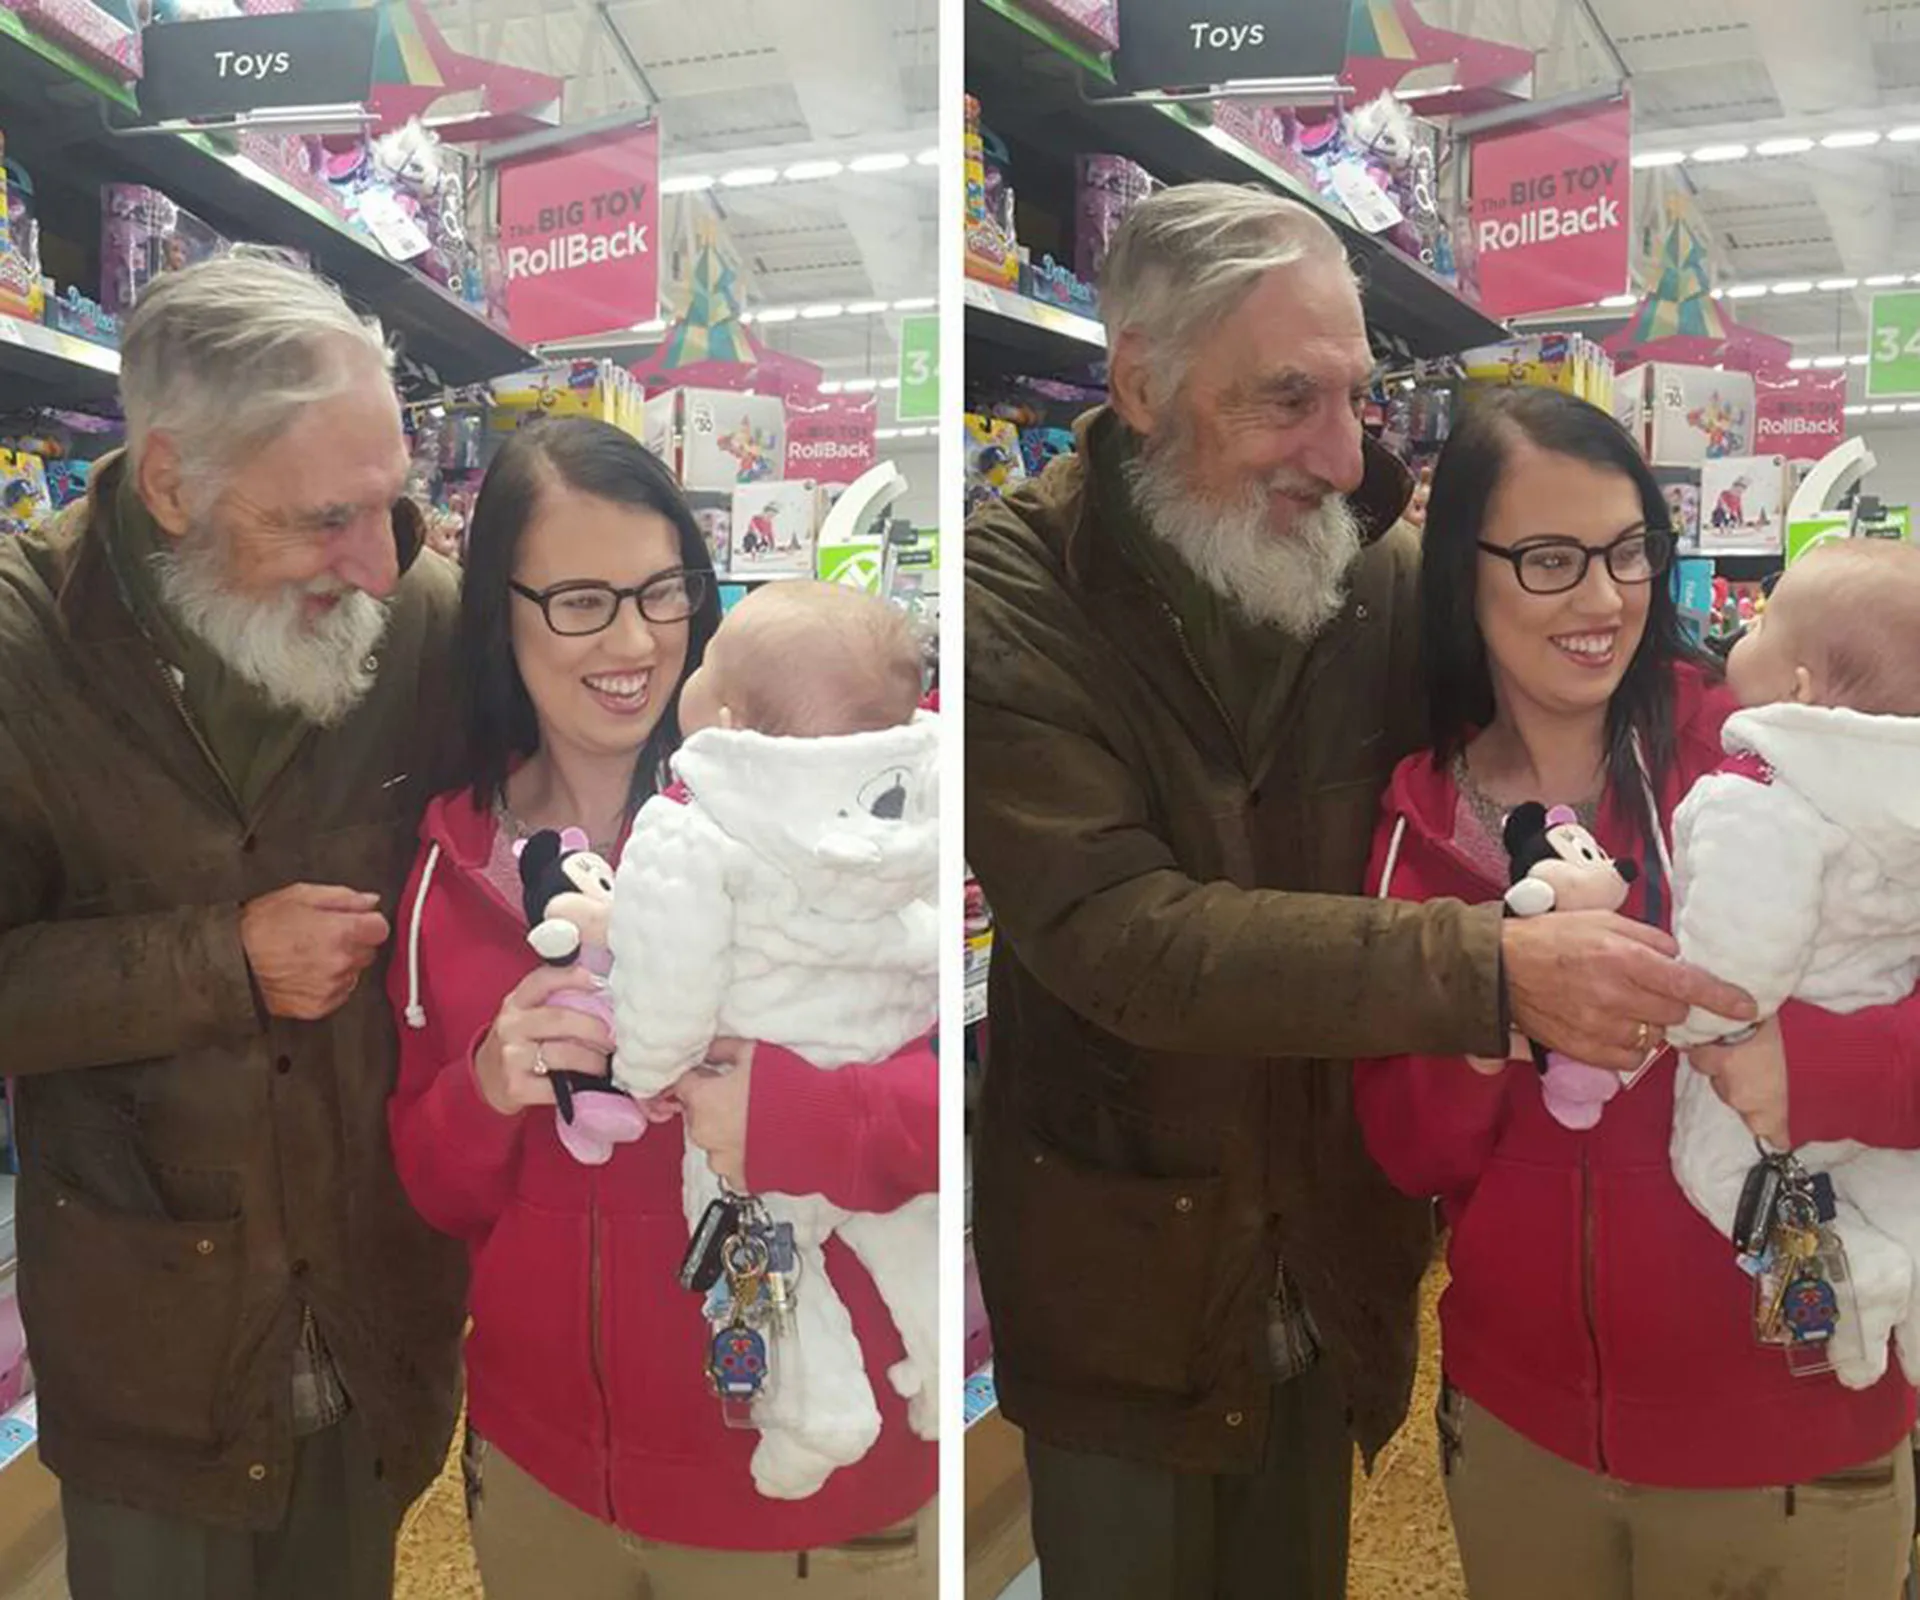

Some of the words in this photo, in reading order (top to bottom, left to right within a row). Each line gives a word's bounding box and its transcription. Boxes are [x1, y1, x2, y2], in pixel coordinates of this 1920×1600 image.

[1189, 20, 1265, 51] Toys
[214, 50, 292, 80] Toys
[1481, 198, 1507, 213] The
[1511, 174, 1556, 206] BIG
[1562, 159, 1618, 194] TOY
[538, 200, 584, 233] BIG
[590, 184, 646, 220] TOY
[1479, 195, 1620, 253] RollBack
[507, 221, 649, 280] RollBack
[1758, 417, 1840, 434] RollBack
[788, 441, 870, 459] RollBack
